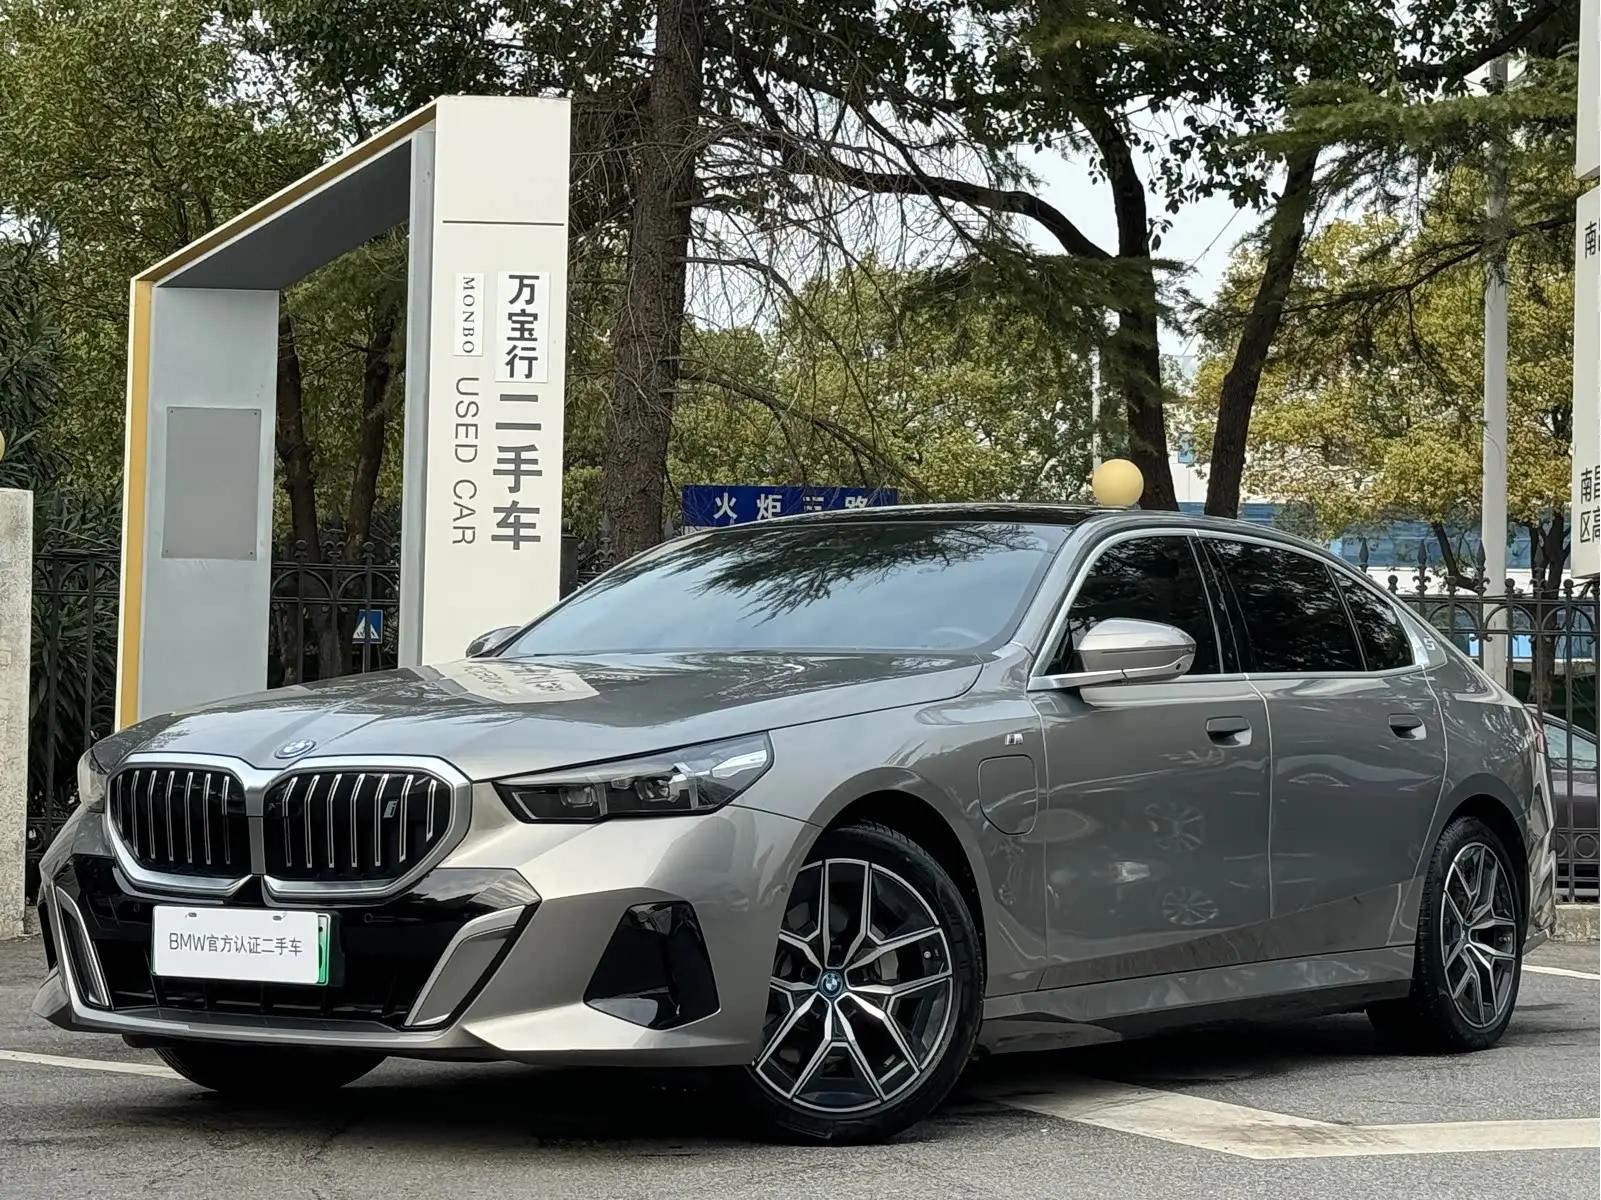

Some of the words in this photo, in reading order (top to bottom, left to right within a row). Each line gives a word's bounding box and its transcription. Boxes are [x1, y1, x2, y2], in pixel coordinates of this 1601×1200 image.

[461, 276, 476, 354] MONBO
[454, 376, 480, 465] USED
[451, 478, 478, 546] CAR
[169, 932, 303, 957] BMW官方认证二手车
